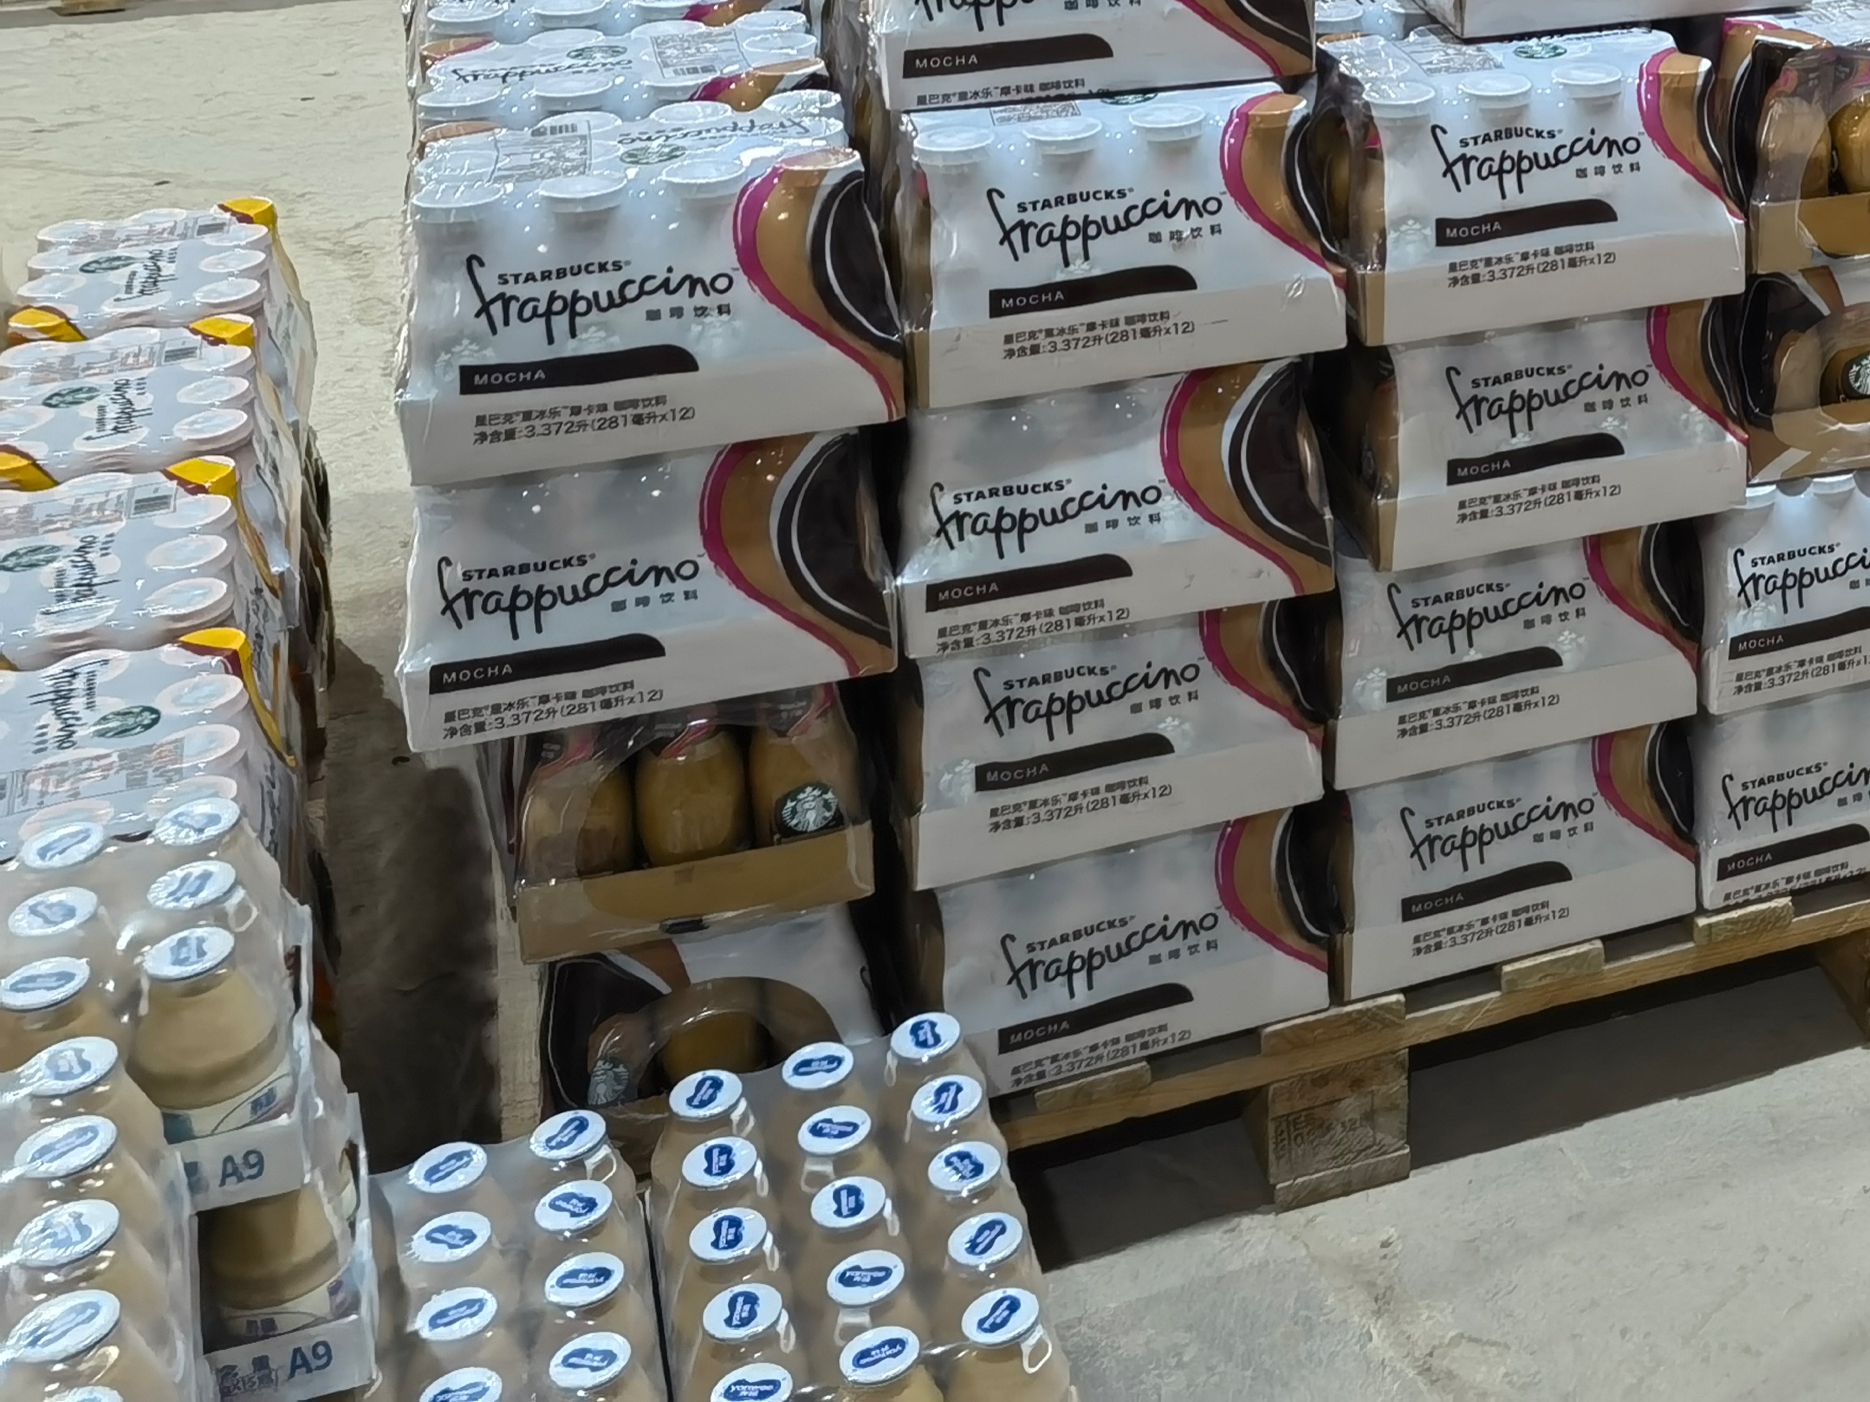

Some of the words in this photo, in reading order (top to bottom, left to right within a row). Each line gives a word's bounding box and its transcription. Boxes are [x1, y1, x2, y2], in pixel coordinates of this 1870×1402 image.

[915, 52, 979, 70] MOCHA
[1430, 123, 1642, 199] frappuccino
[986, 187, 1223, 267] frappuccino
[1445, 220, 1502, 240] MOCHA
[466, 253, 735, 345] frappuccino
[1001, 289, 1065, 309] MOCHA
[473, 369, 547, 387] MOCHA
[1445, 363, 1650, 437] frappuccino
[1456, 458, 1512, 476] MOCHA
[930, 482, 1162, 559] frappuccino
[436, 555, 700, 641] frappuccino
[938, 581, 999, 603] MOCHA
[1387, 581, 1586, 654] frappuccino
[1738, 634, 1784, 651] MOCHA
[442, 662, 513, 684] MOCHA
[1396, 674, 1451, 695] MOCHA
[972, 659, 1200, 741] frappuccino
[985, 762, 1049, 783] MOCHA
[1400, 795, 1595, 873] frappuccino
[1726, 851, 1772, 871] MOCHA
[1411, 891, 1464, 913] MOCHA
[999, 911, 1219, 1000] frappuccino
[1009, 1020, 1070, 1045] MOCHA
[218, 1149, 265, 1188] A9
[287, 1340, 334, 1378] A9
